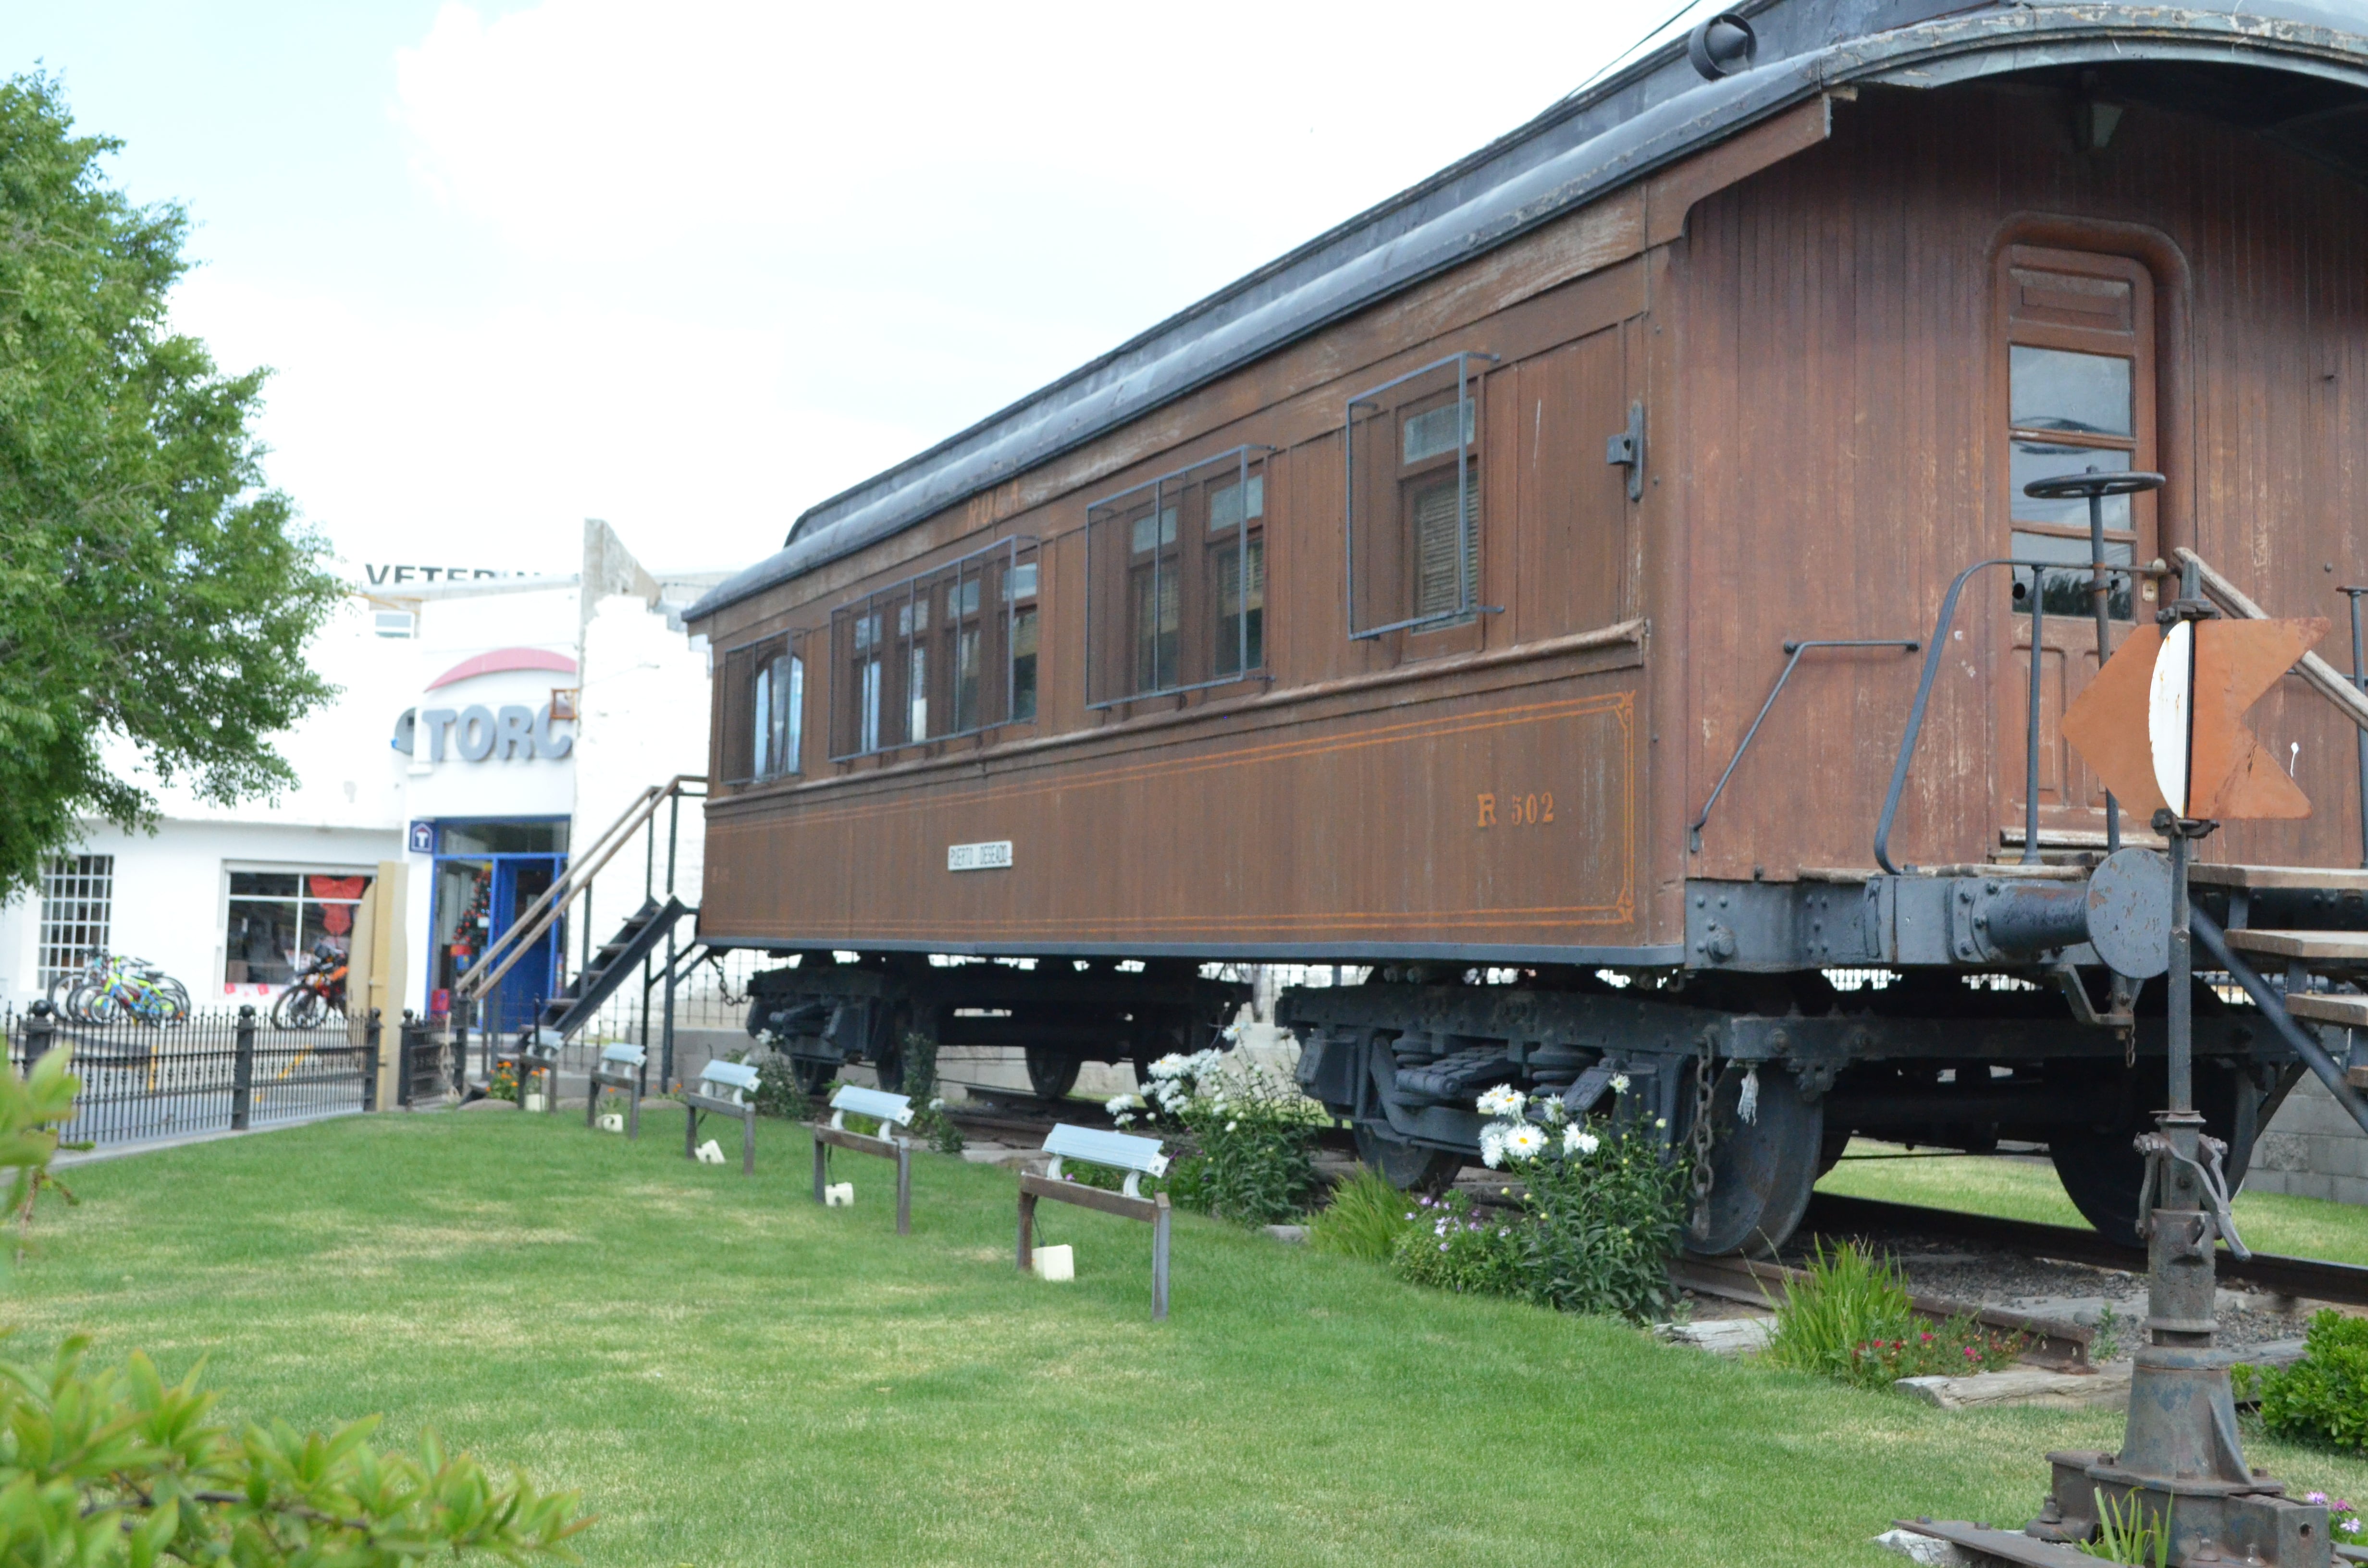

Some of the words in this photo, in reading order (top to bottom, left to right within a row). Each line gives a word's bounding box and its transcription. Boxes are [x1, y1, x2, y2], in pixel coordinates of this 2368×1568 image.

[421, 704, 573, 763] TORC
[1477, 792, 1497, 827] R
[1511, 791, 1554, 826] 502
